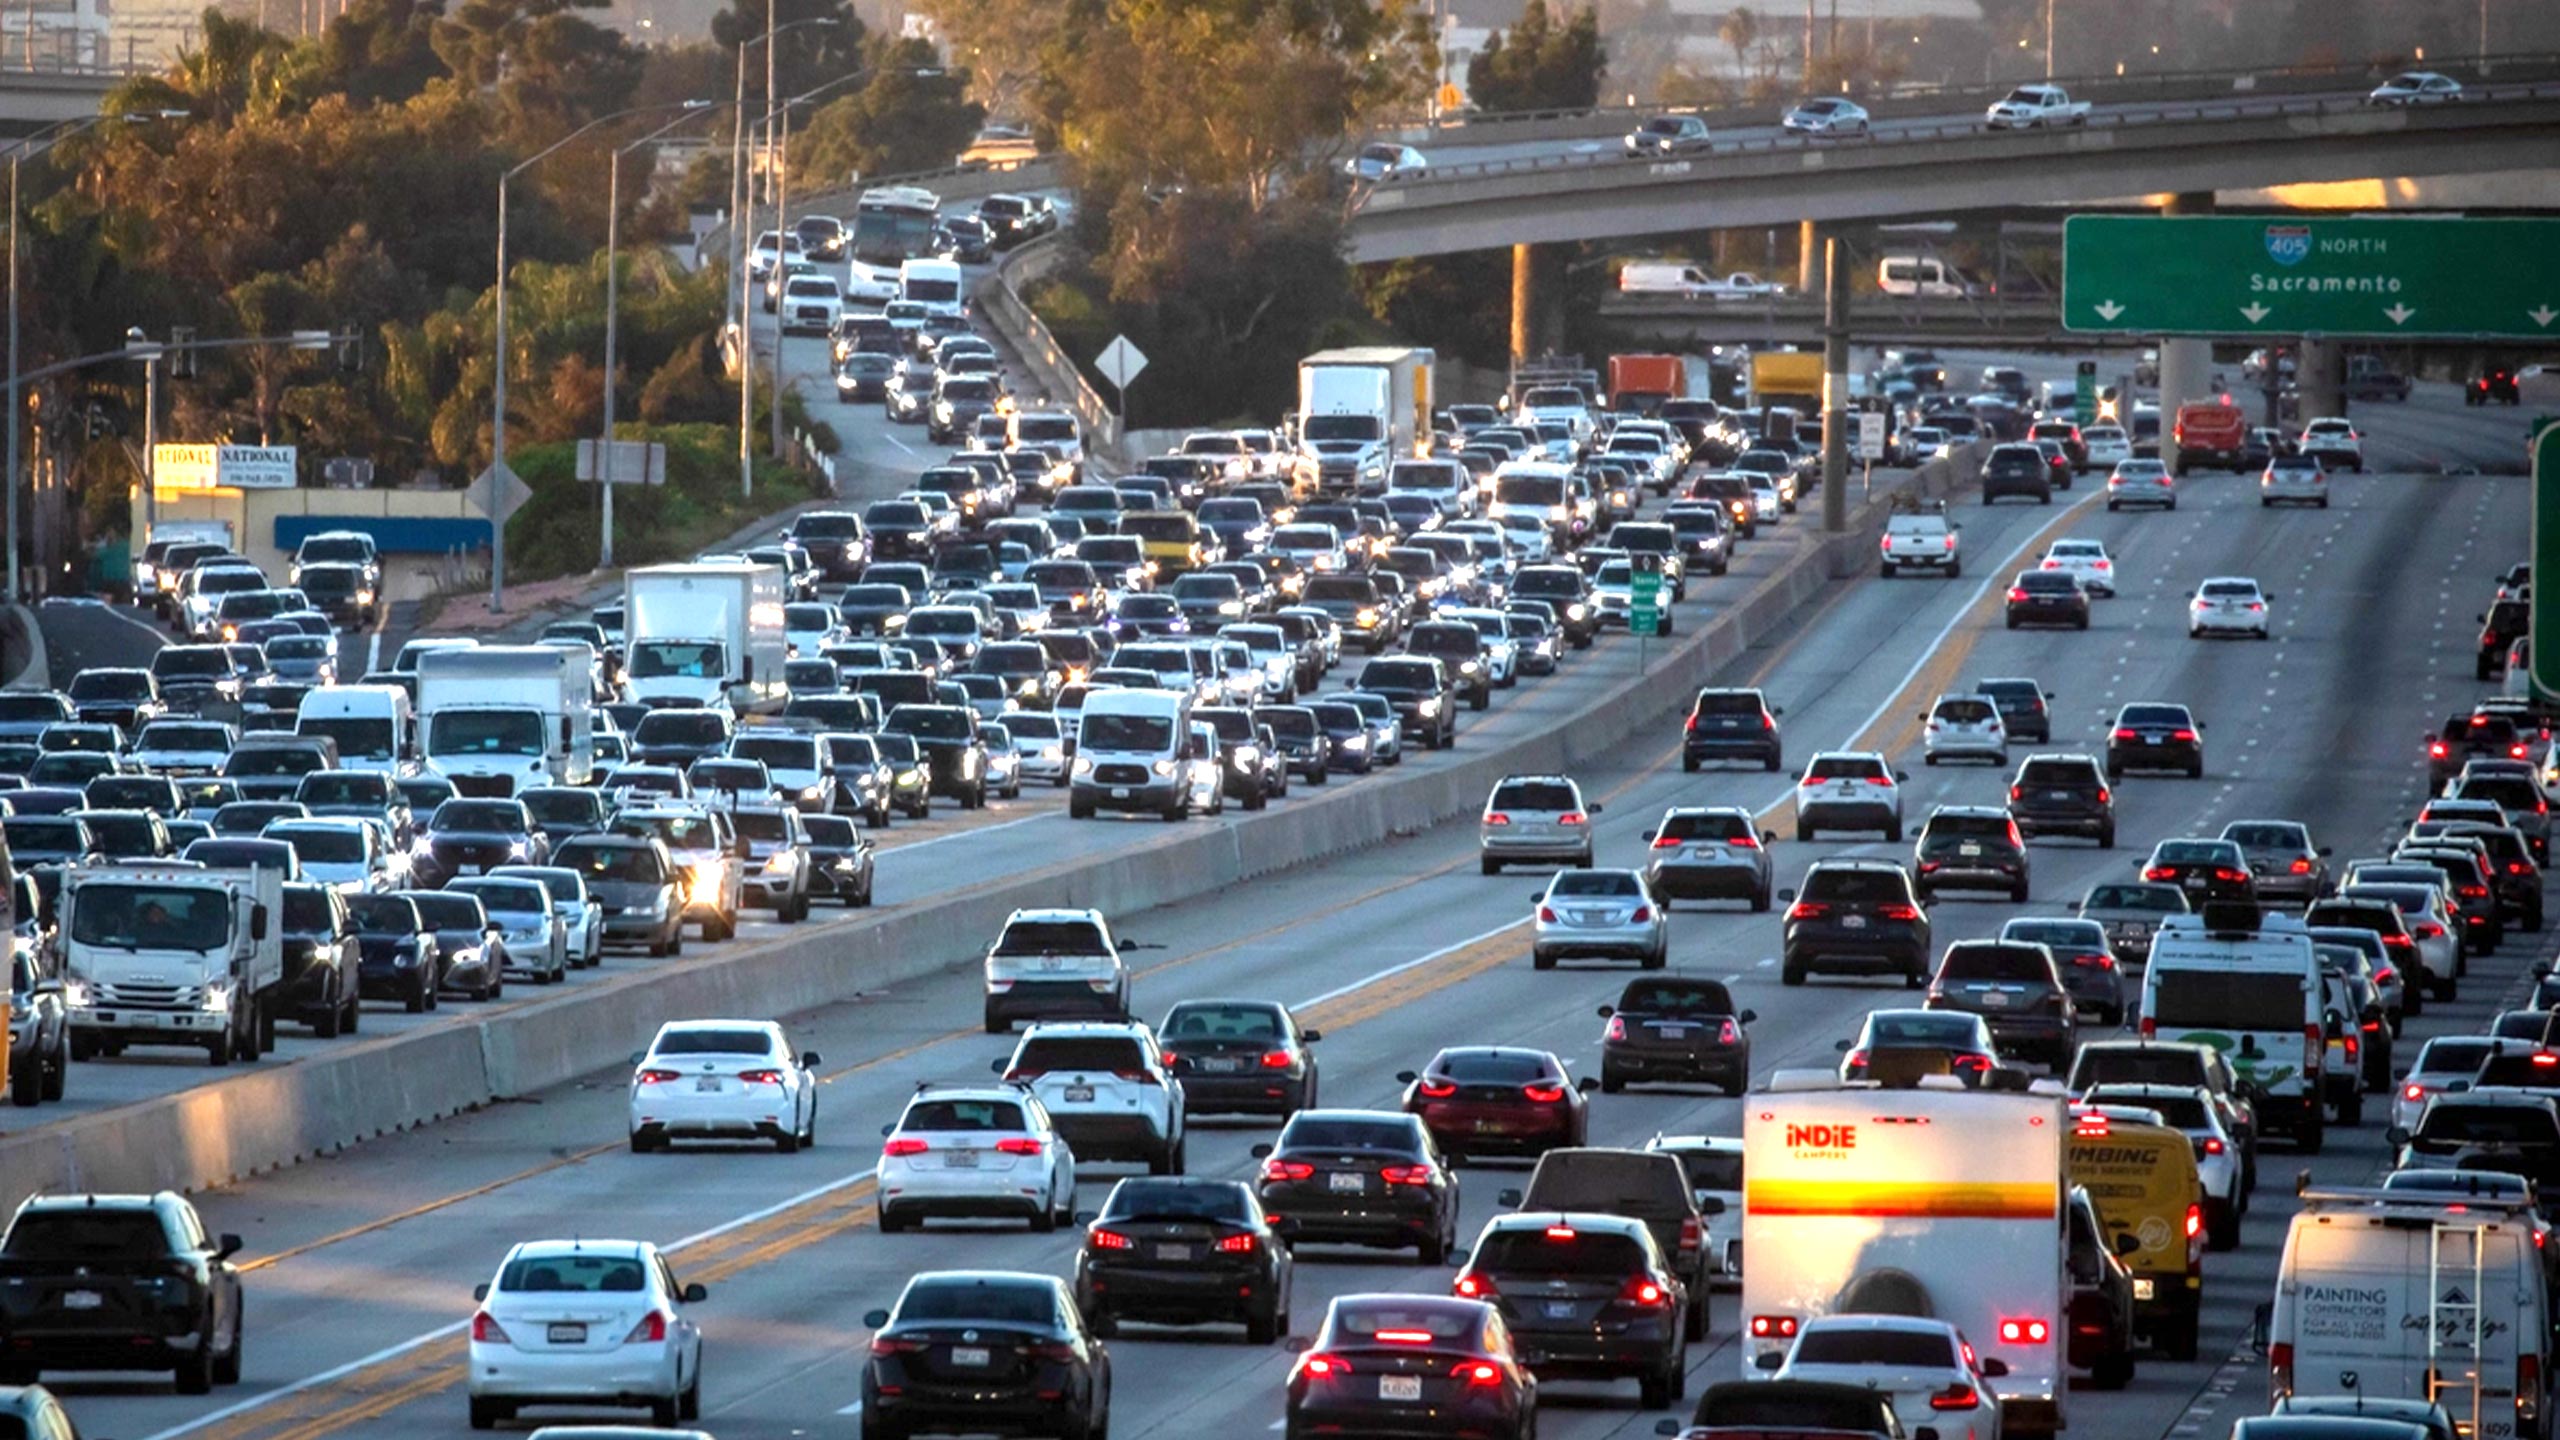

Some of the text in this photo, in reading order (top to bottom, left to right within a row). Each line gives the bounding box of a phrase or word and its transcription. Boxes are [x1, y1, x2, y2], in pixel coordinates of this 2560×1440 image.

[2271, 238, 2388, 255] 405 NORTH
[2250, 273, 2402, 292] Sacramento
[221, 449, 291, 464] NATIONAL
[1794, 1150, 1848, 1160] CAMPERS
[2305, 1286, 2387, 1305] PAINTING
[2305, 1303, 2387, 1318] CONTRACTORS
[2303, 1317, 2326, 1328] FOR
[2353, 1319, 2386, 1332] YOUR
